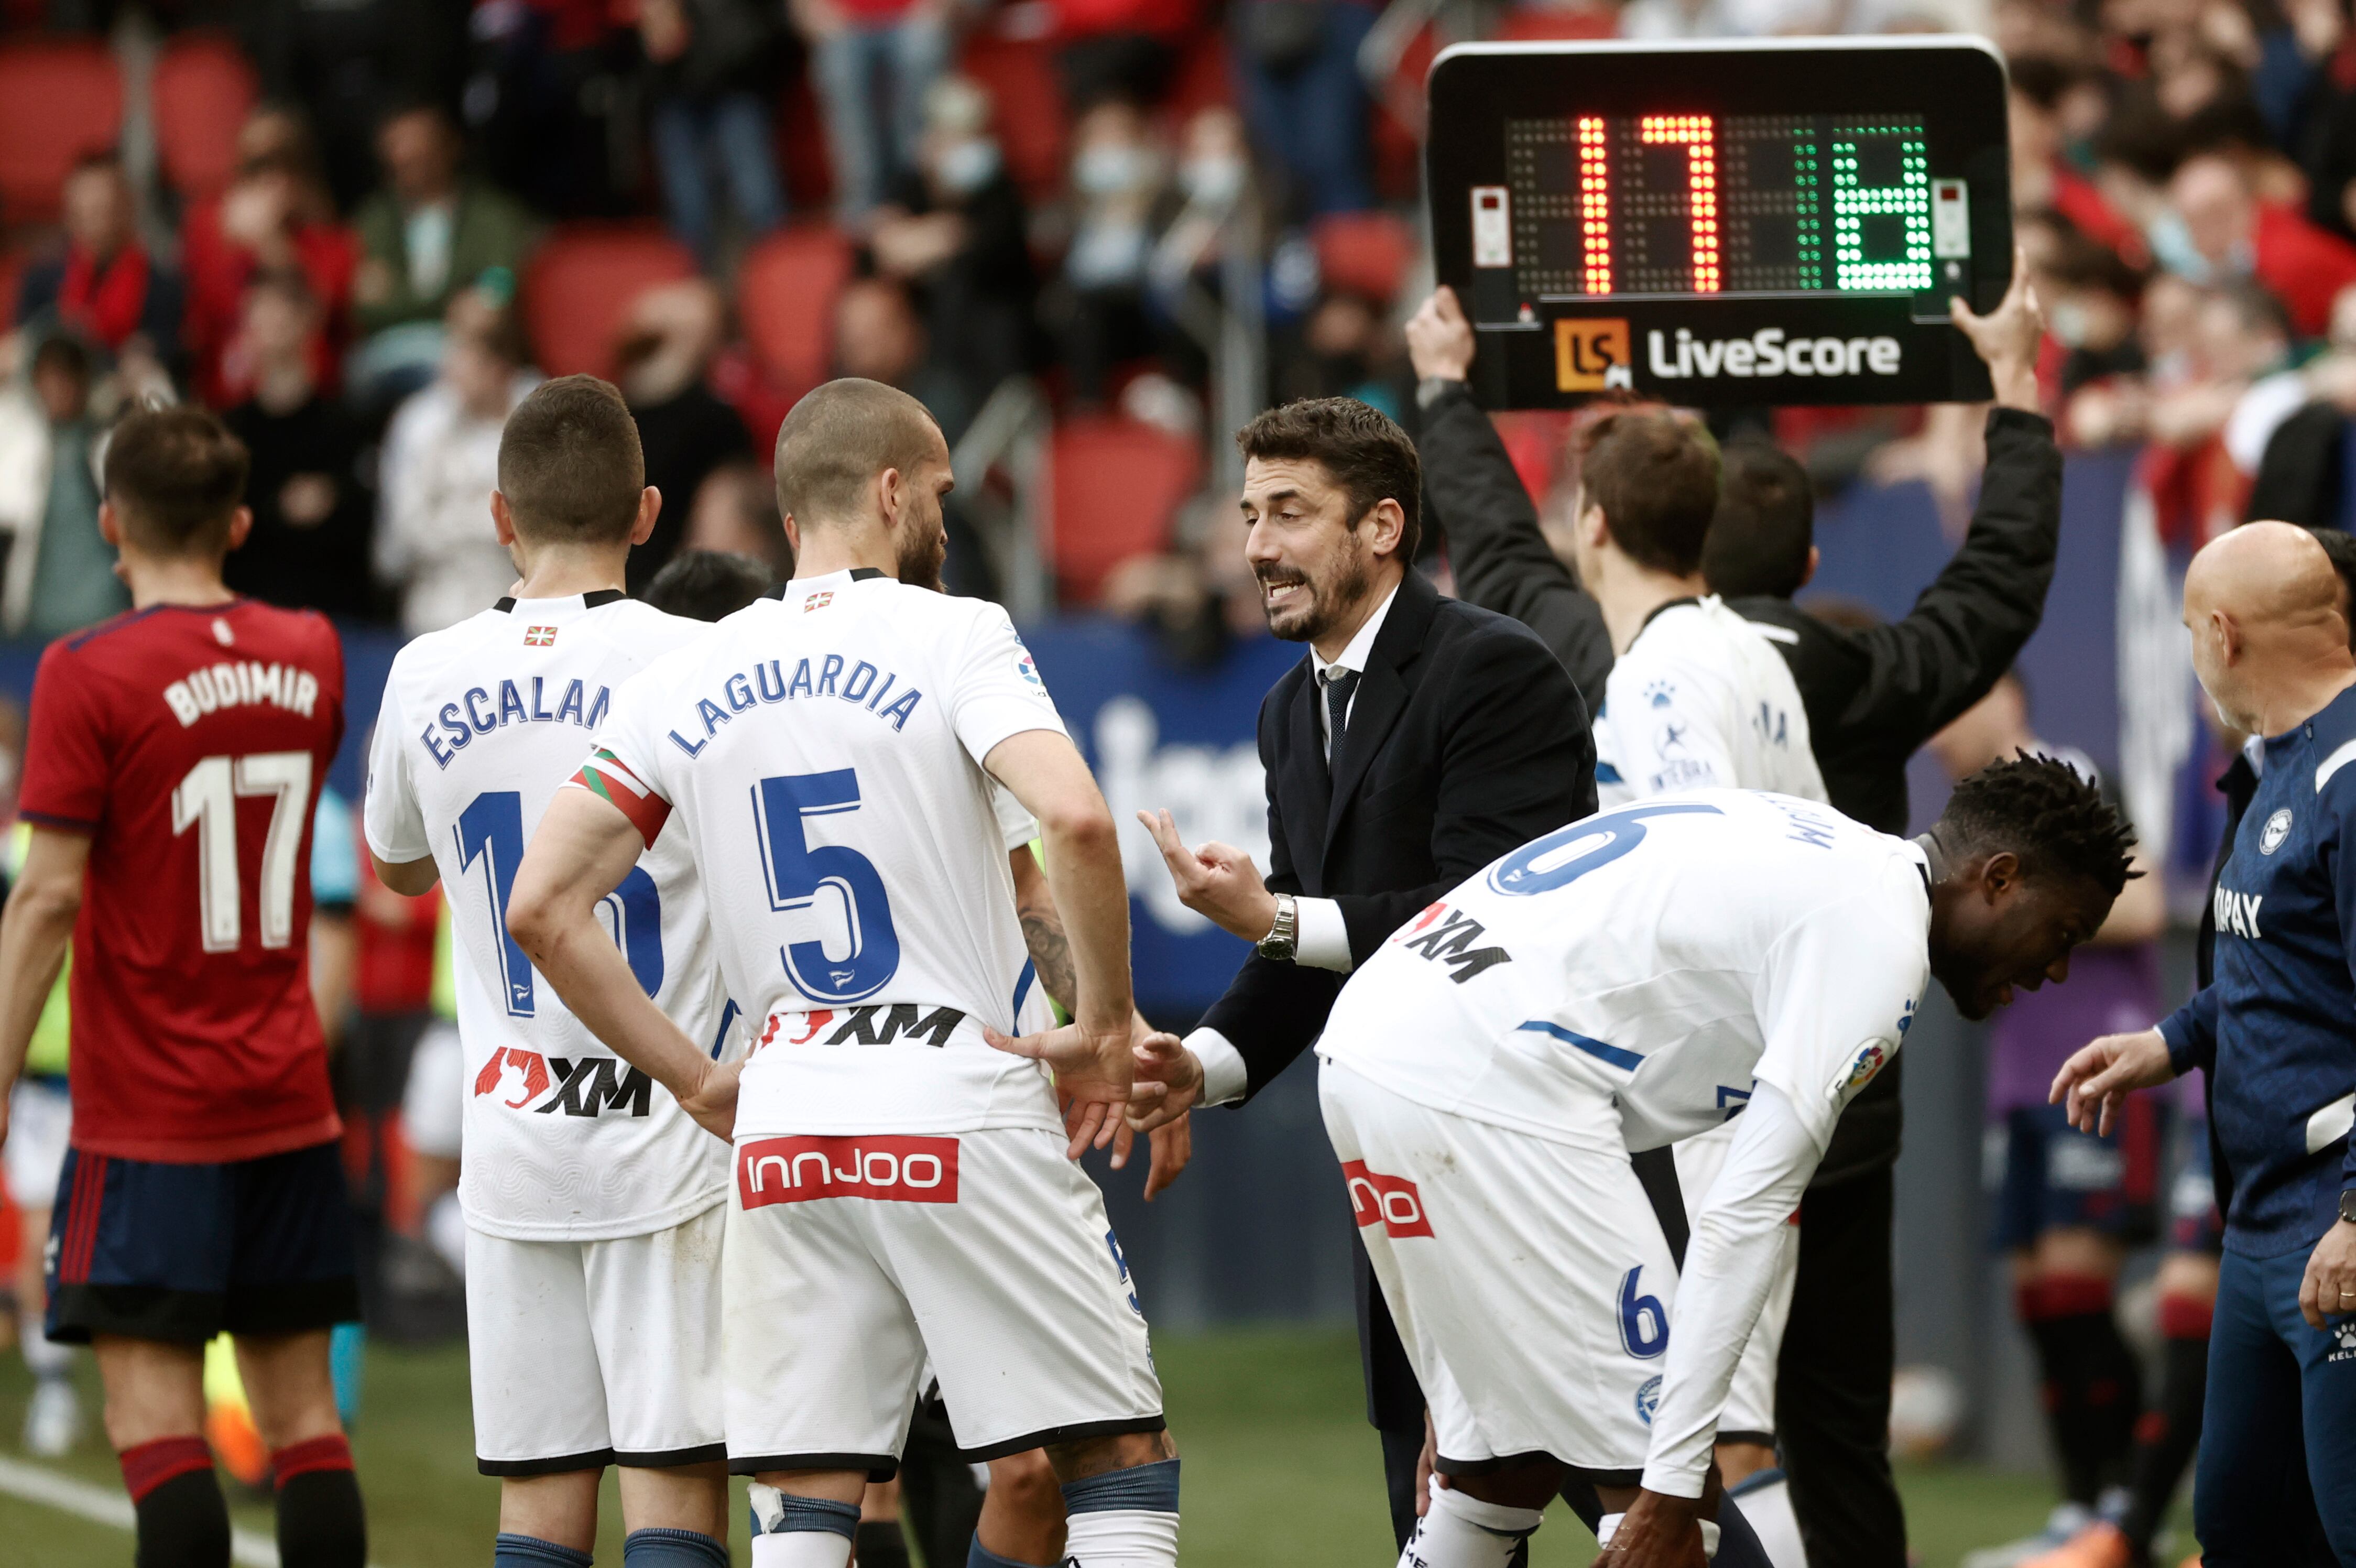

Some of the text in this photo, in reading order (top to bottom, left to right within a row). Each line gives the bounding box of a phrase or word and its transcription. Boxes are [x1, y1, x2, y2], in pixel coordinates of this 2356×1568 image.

[1578, 115, 1720, 296] 17
[1572, 328, 1901, 378] LS LiveScore
[163, 660, 319, 729] BUDIMIR
[667, 654, 923, 760] LAGUARDIA
[171, 749, 313, 954] 17
[750, 767, 900, 1005] 5
[1404, 909, 1512, 985] XM
[823, 1004, 967, 1048] XM
[532, 1057, 652, 1118] XM
[1617, 1265, 1670, 1360] 6
